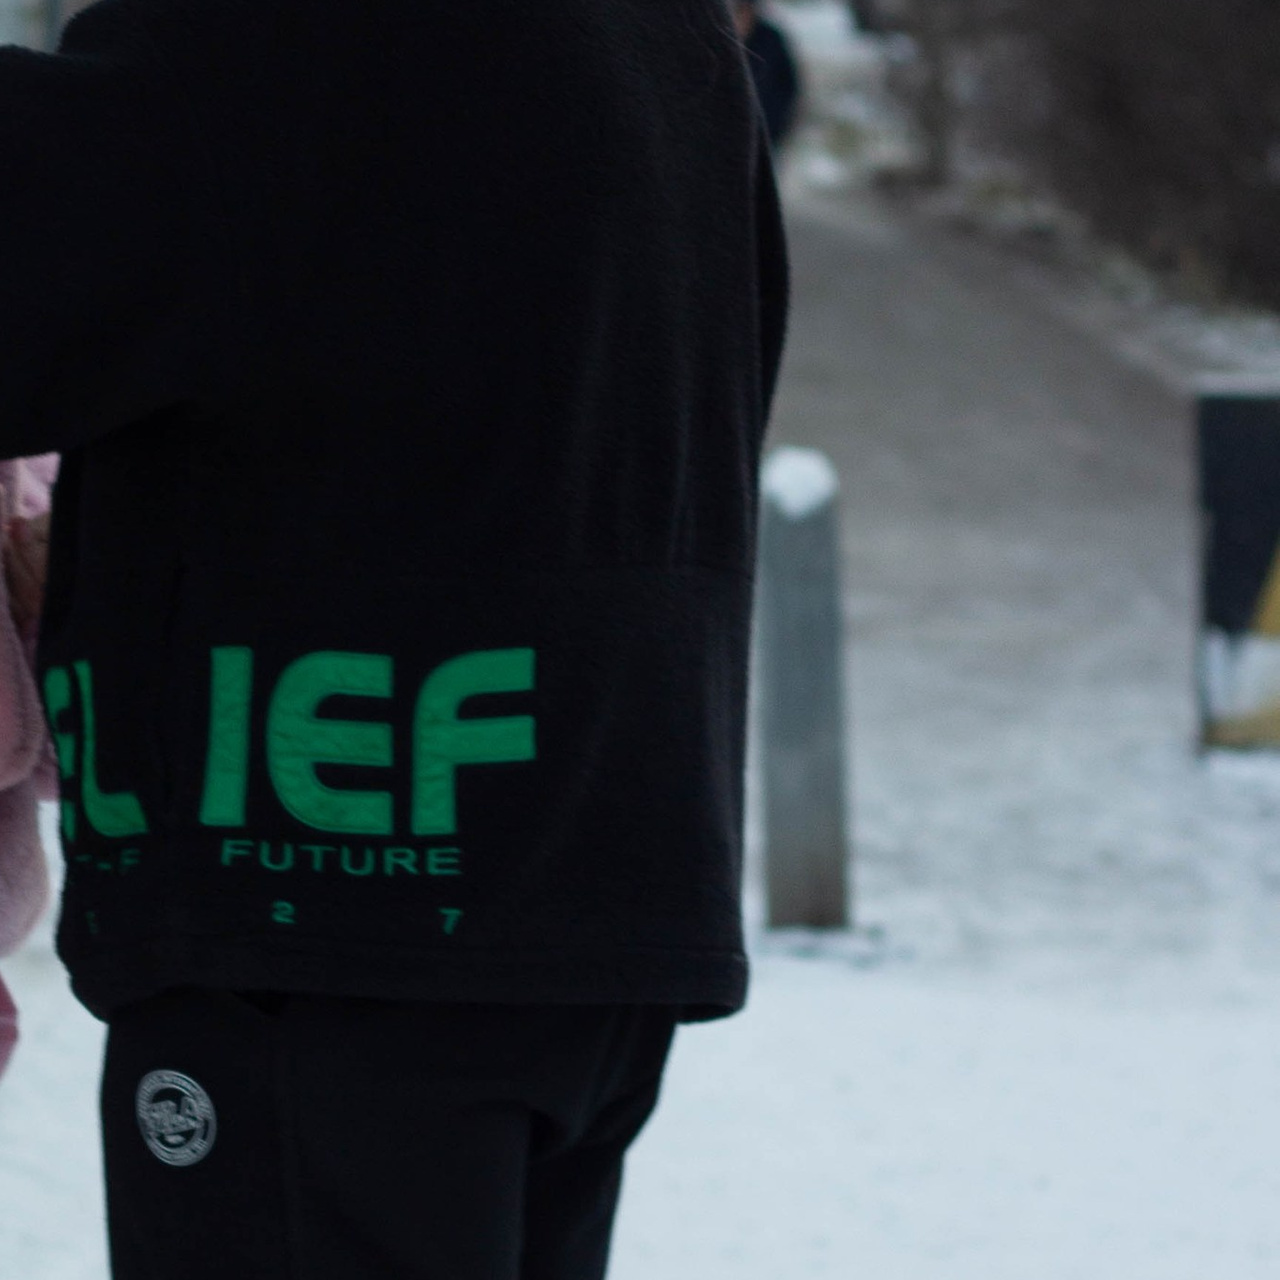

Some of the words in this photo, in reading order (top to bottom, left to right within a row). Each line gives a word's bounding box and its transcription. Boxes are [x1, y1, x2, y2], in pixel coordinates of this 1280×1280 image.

[220, 837, 463, 877] FUTURE
[270, 899, 296, 925] 2
[438, 907, 463, 936] 7
